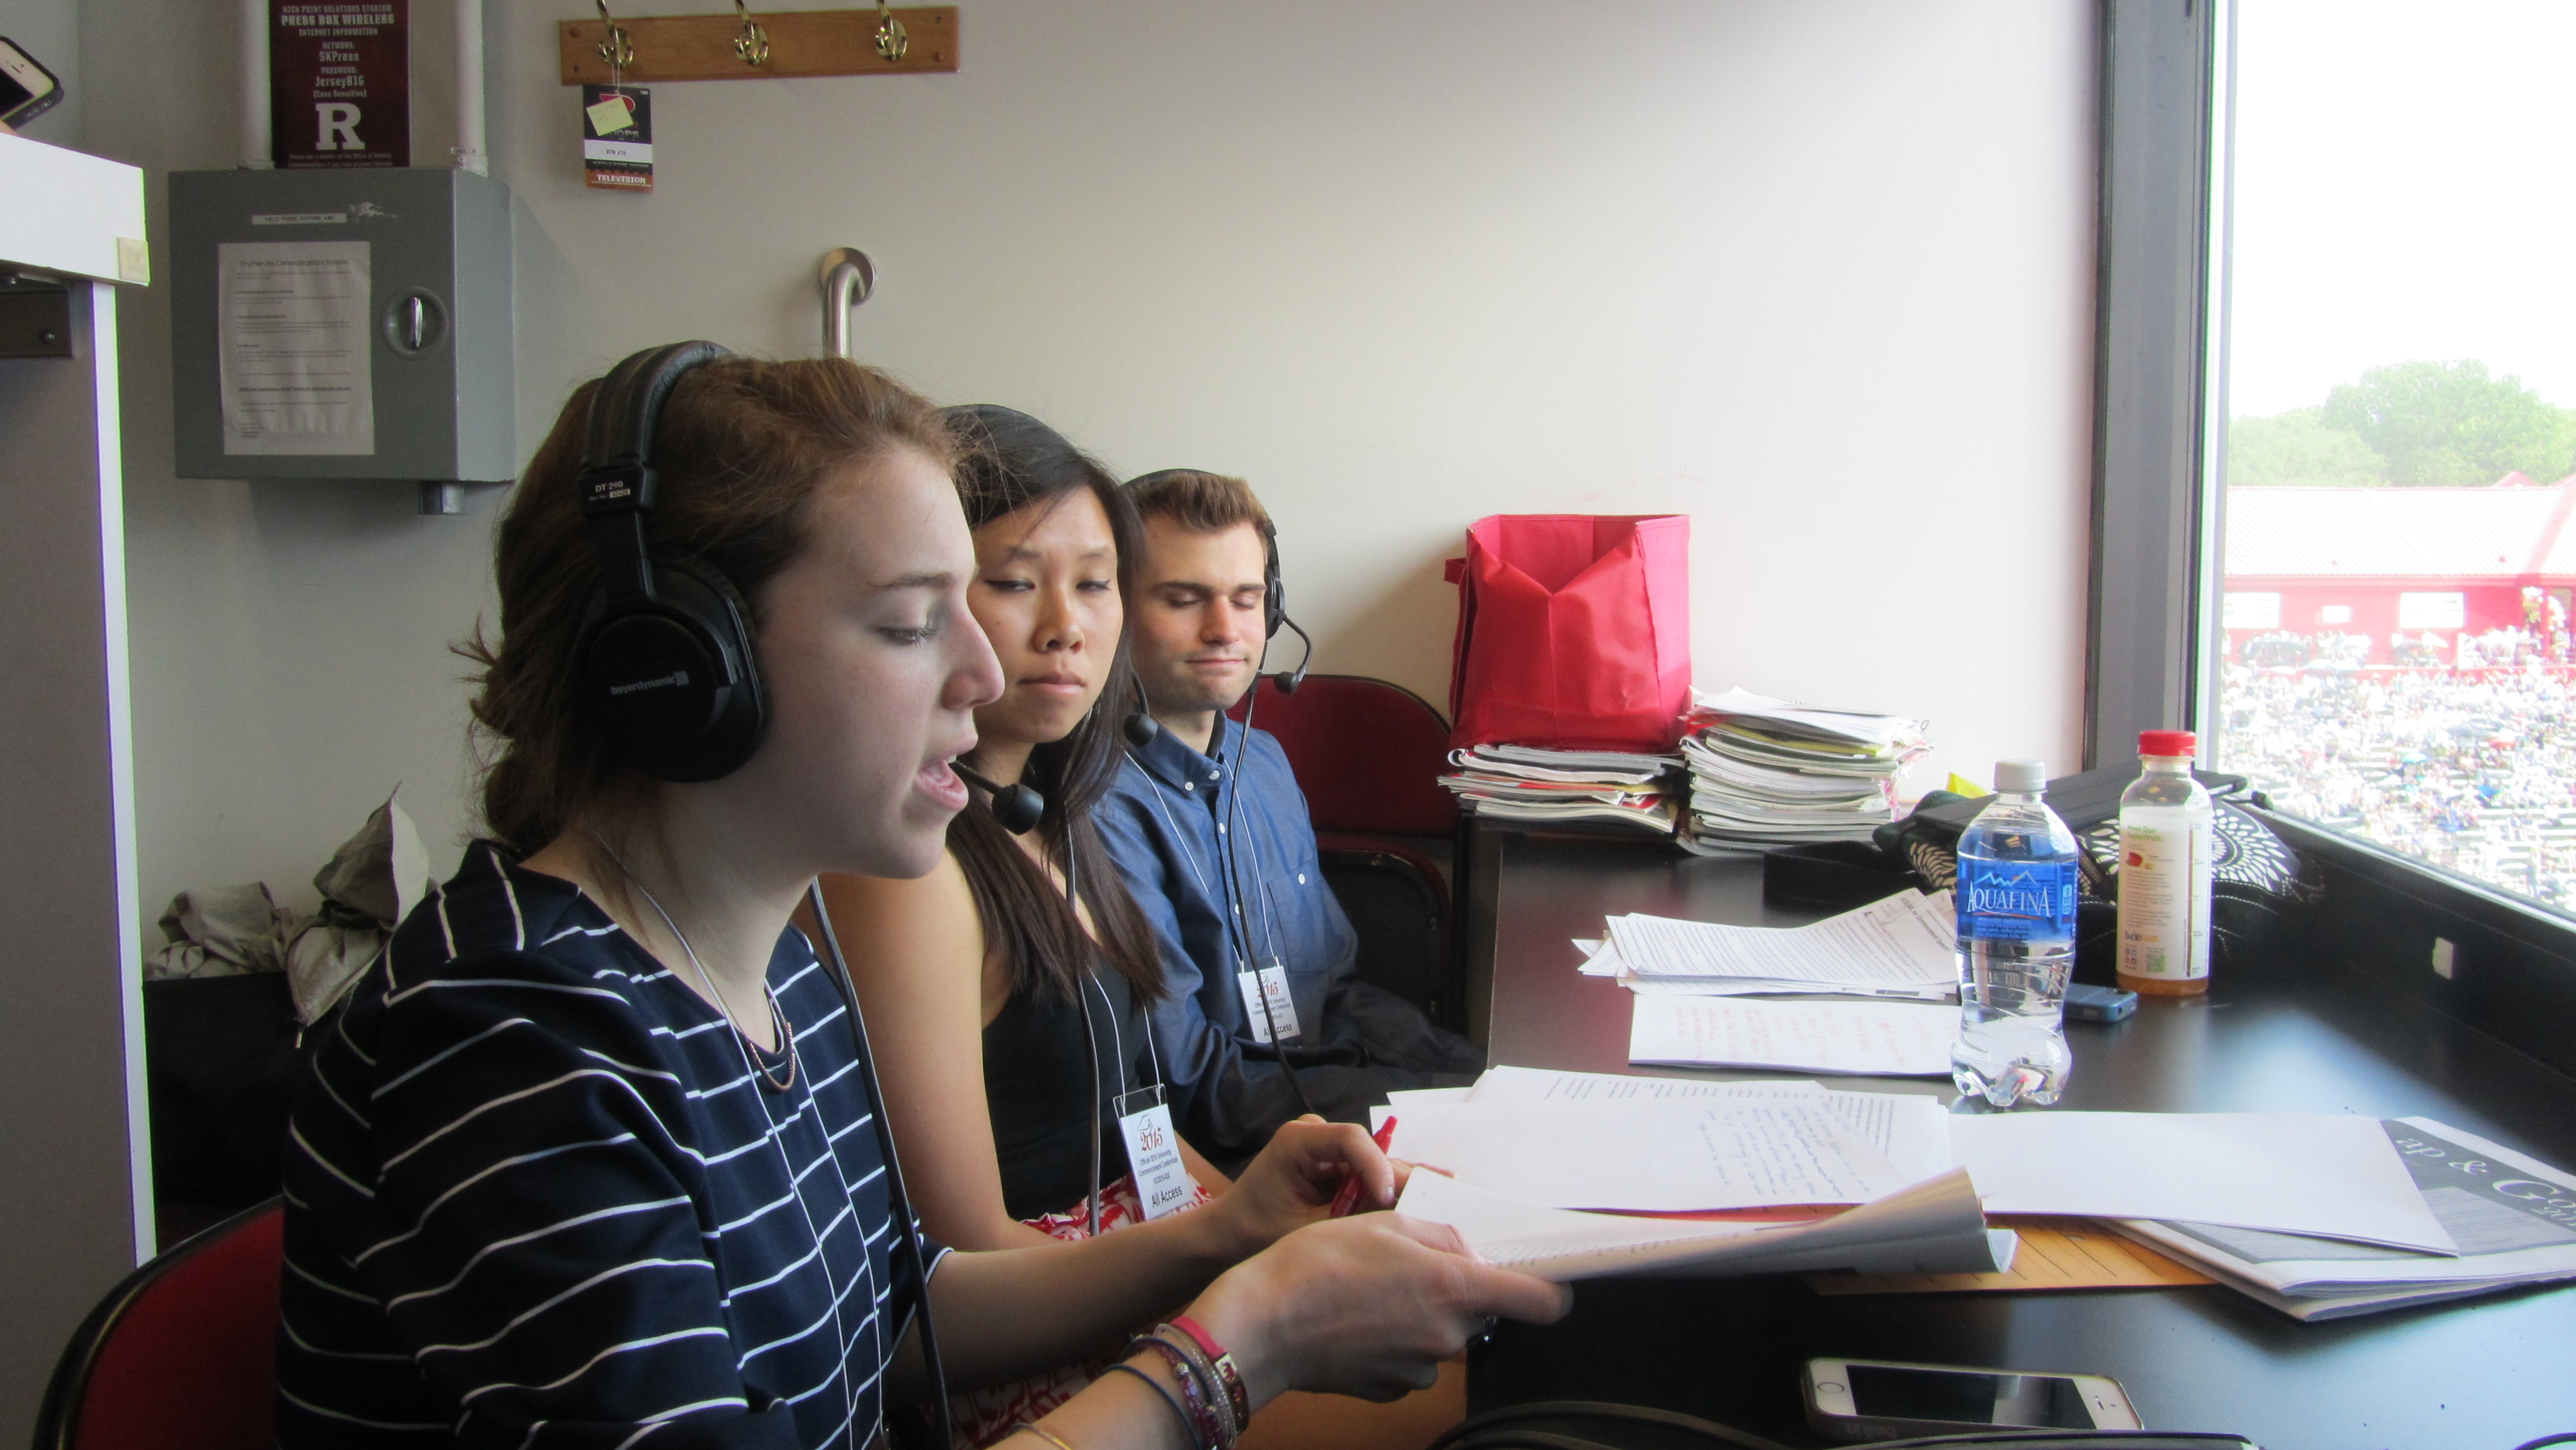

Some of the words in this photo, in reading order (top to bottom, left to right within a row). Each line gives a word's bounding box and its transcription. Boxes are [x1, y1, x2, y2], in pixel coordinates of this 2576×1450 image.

[302, 5, 322, 13] POINT
[281, 14, 316, 26] PRESS
[318, 14, 340, 26] BOX
[342, 13, 395, 26] WIRELESS
[333, 27, 379, 36] INFORMATION
[319, 51, 360, 62] SKPress
[315, 102, 366, 150] R
[597, 174, 646, 184] TELEVISION
[595, 484, 607, 492] DT
[608, 480, 624, 490] 290
[610, 676, 676, 695] beyerdynamic
[1966, 881, 2052, 918] AQUAFINA
[1276, 1024, 1293, 1033] ccess
[1140, 1127, 1163, 1152] 2015
[2448, 1160, 2488, 1176] &
[2493, 1179, 2576, 1213] Go
[1151, 1191, 1161, 1208] All
[1161, 1186, 1183, 1204] Access
